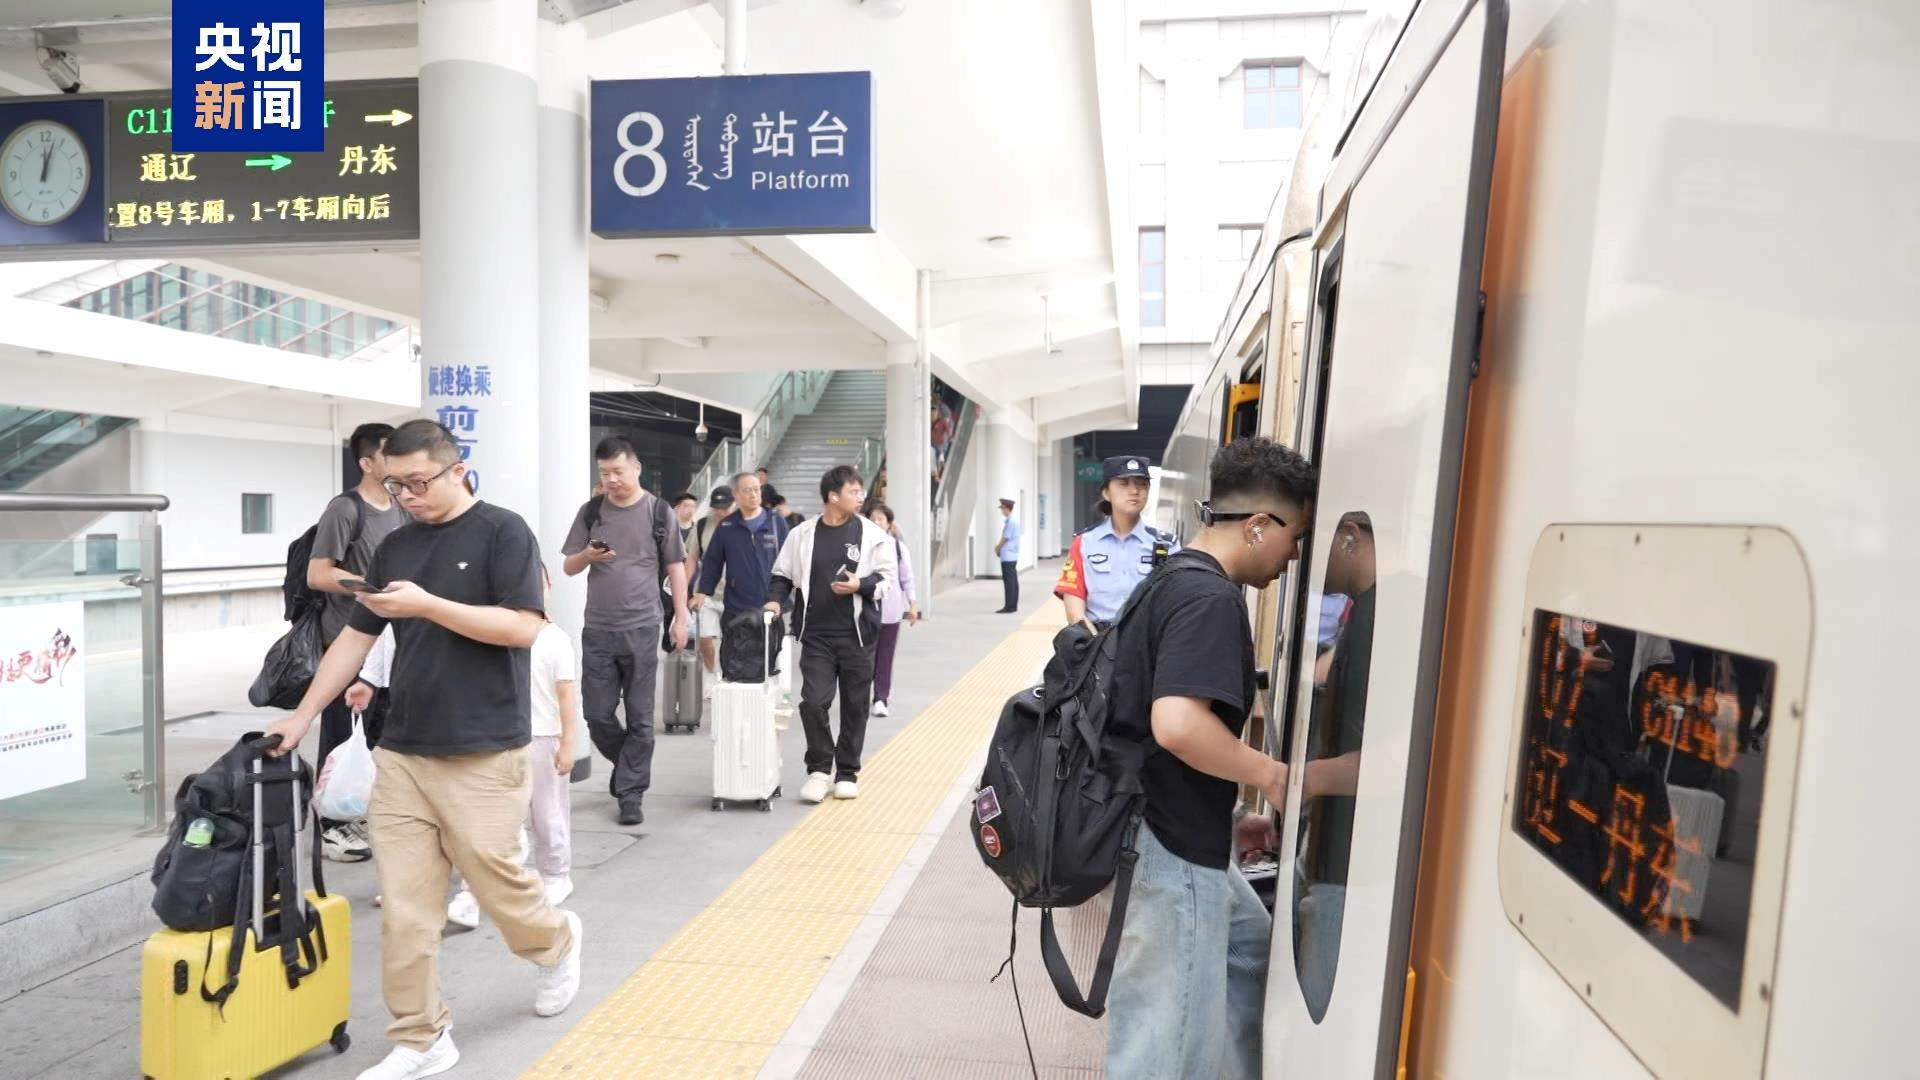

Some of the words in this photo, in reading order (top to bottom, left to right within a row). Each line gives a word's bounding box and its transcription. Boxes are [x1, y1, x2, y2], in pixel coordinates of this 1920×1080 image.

[613, 111, 667, 197] 8
[752, 111, 848, 157] 站台
[140, 153, 197, 182] 通辽
[339, 144, 398, 176] 丹东
[751, 171, 849, 190] Platform
